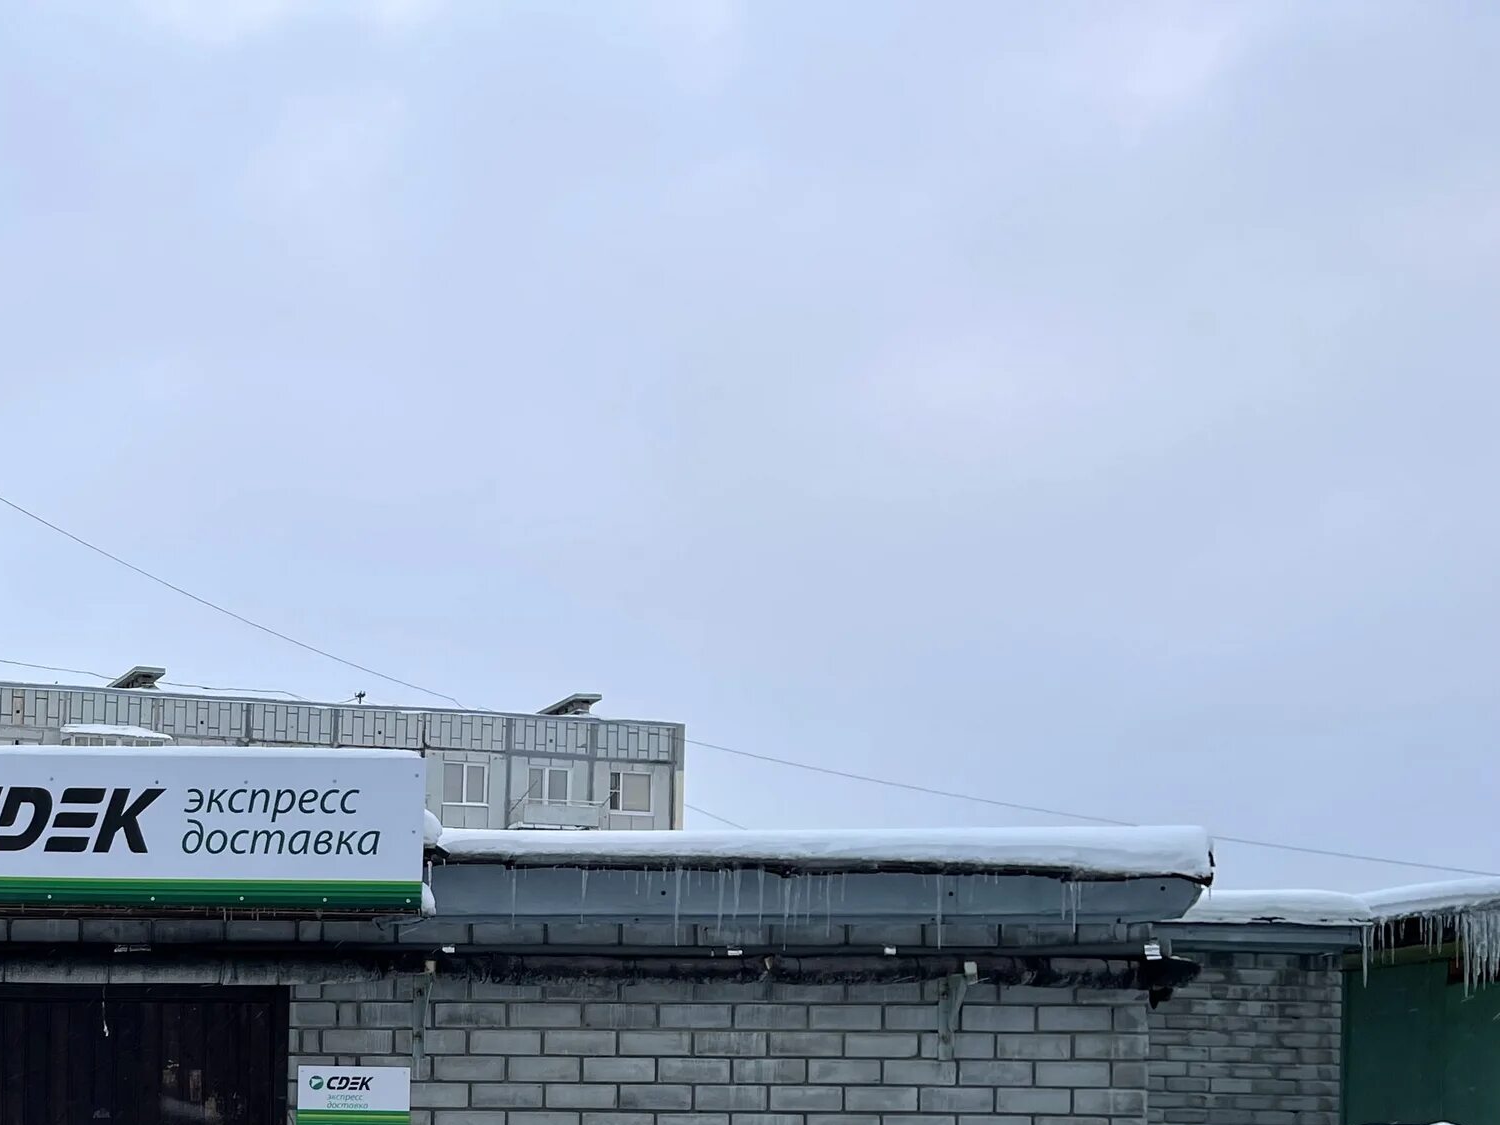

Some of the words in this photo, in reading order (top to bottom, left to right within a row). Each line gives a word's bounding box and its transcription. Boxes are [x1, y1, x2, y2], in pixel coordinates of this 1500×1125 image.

[185, 785, 359, 822] экспресс
[182, 820, 380, 856] доставка
[327, 1076, 373, 1090] CDEK
[327, 1101, 368, 1109] доставка
